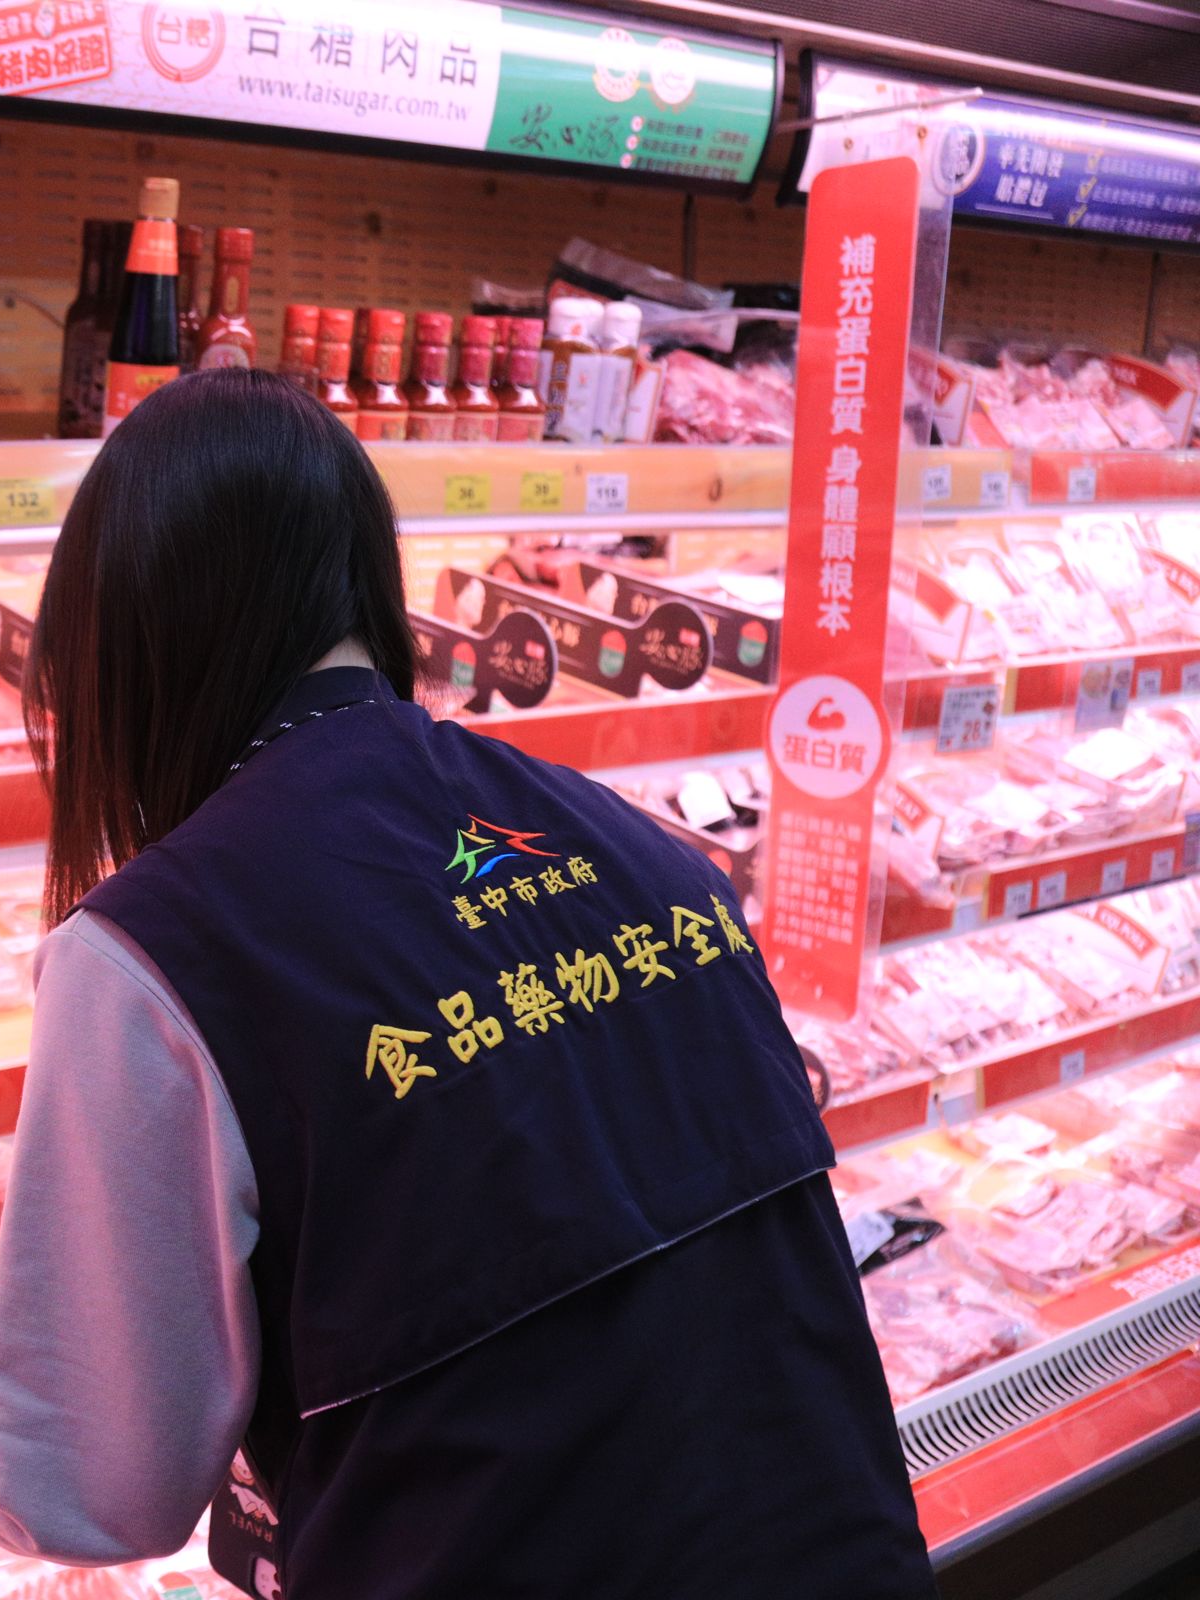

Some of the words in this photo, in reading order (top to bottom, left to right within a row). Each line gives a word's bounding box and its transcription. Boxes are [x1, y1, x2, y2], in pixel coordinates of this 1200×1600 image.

[237, 72, 471, 121] www.taisugar.com.tw
[830, 234, 877, 435] 補充蛋白質
[7, 492, 39, 508] 132
[816, 444, 863, 637] 身體顧根本
[783, 735, 866, 775] 蛋白質
[450, 856, 599, 930] 臺中市政府
